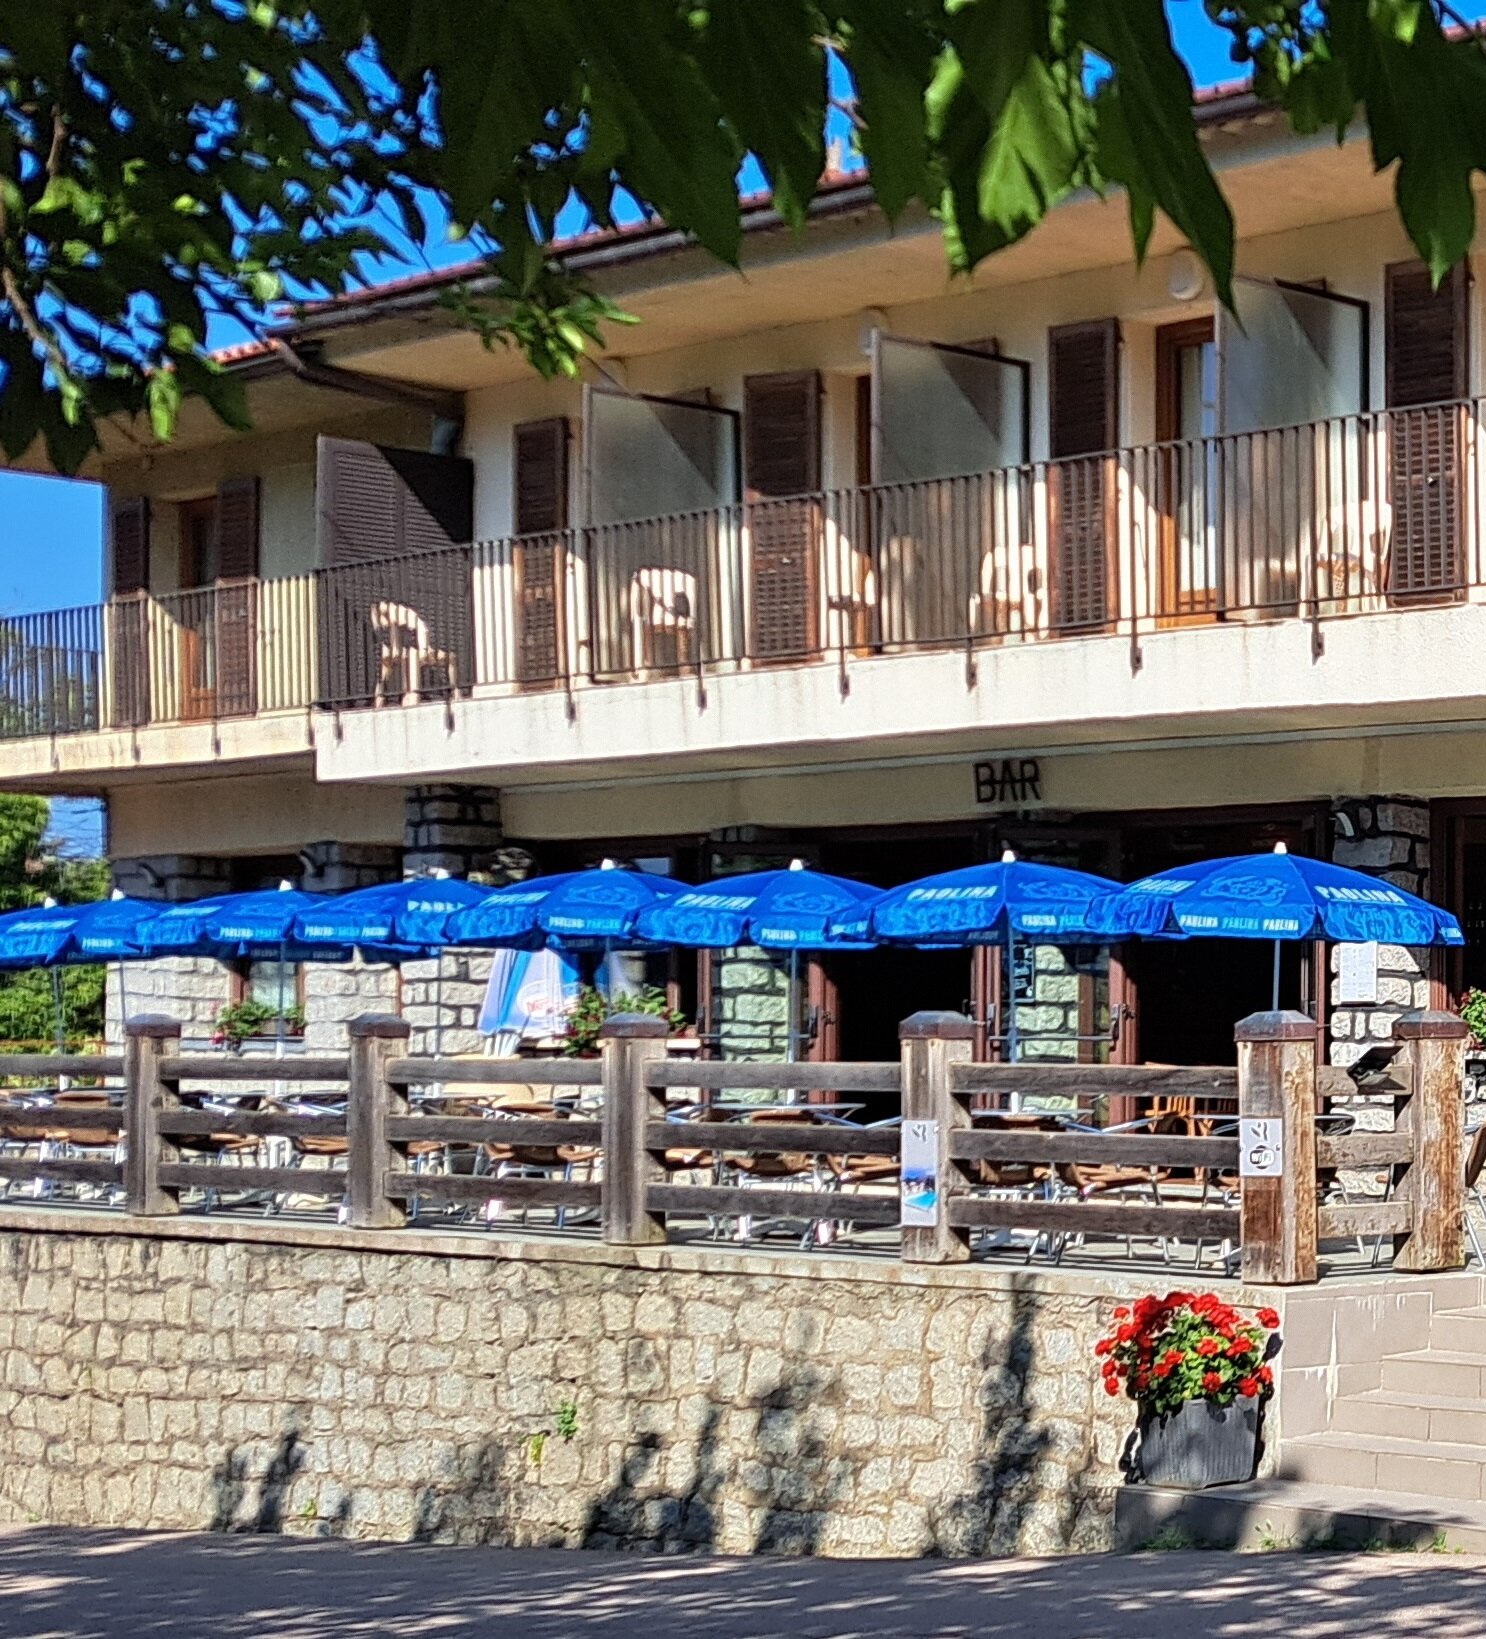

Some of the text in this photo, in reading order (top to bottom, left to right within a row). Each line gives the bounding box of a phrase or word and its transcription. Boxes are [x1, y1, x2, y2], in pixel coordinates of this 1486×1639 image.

[974, 760, 1041, 803] BAR
[907, 886, 998, 900] PAOLINA
[1314, 885, 1408, 906] PAOLINA
[1180, 914, 1218, 928] PAOLINA
[1262, 919, 1299, 931] PAOLINA
